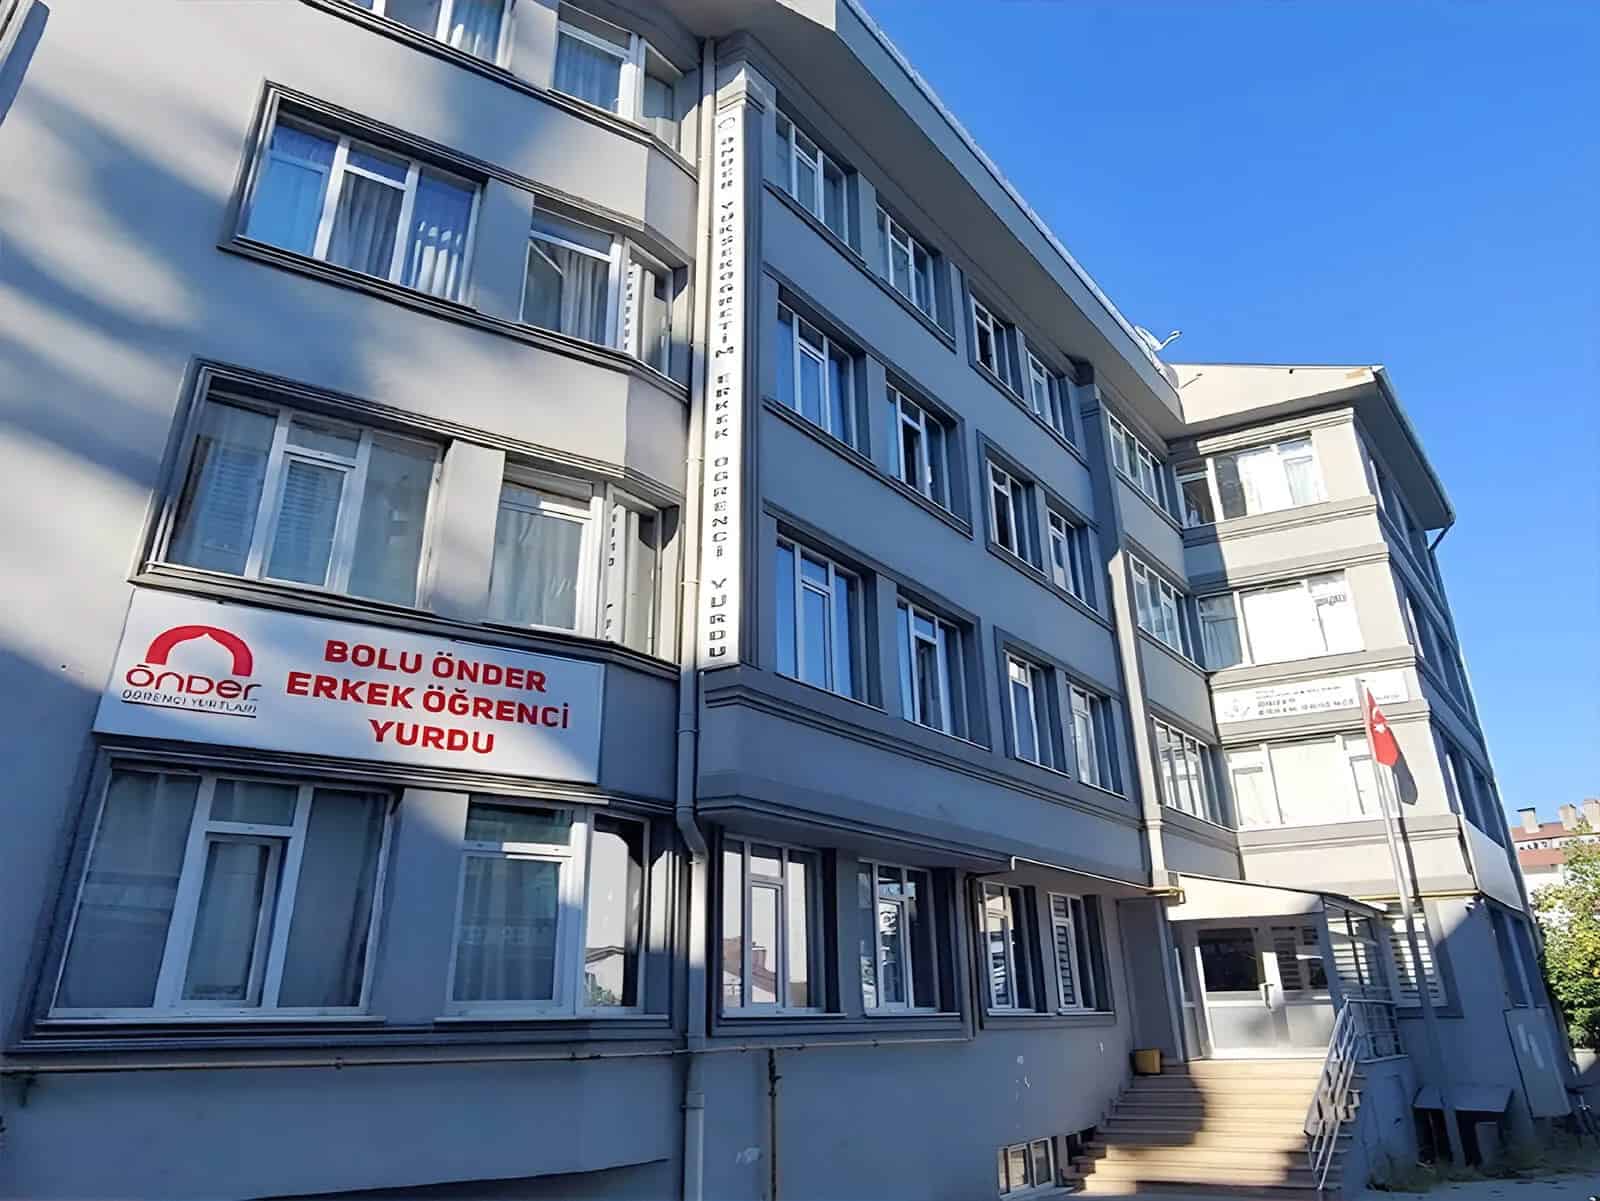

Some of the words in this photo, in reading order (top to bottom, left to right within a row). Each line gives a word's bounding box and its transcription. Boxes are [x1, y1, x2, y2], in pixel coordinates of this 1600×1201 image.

[325, 639, 422, 674] BOLU
[431, 650, 546, 694] ÖNDER
[287, 671, 414, 709] ERKEK
[422, 684, 569, 729] ÖĞRENCİ
[371, 719, 495, 755] YURDU
